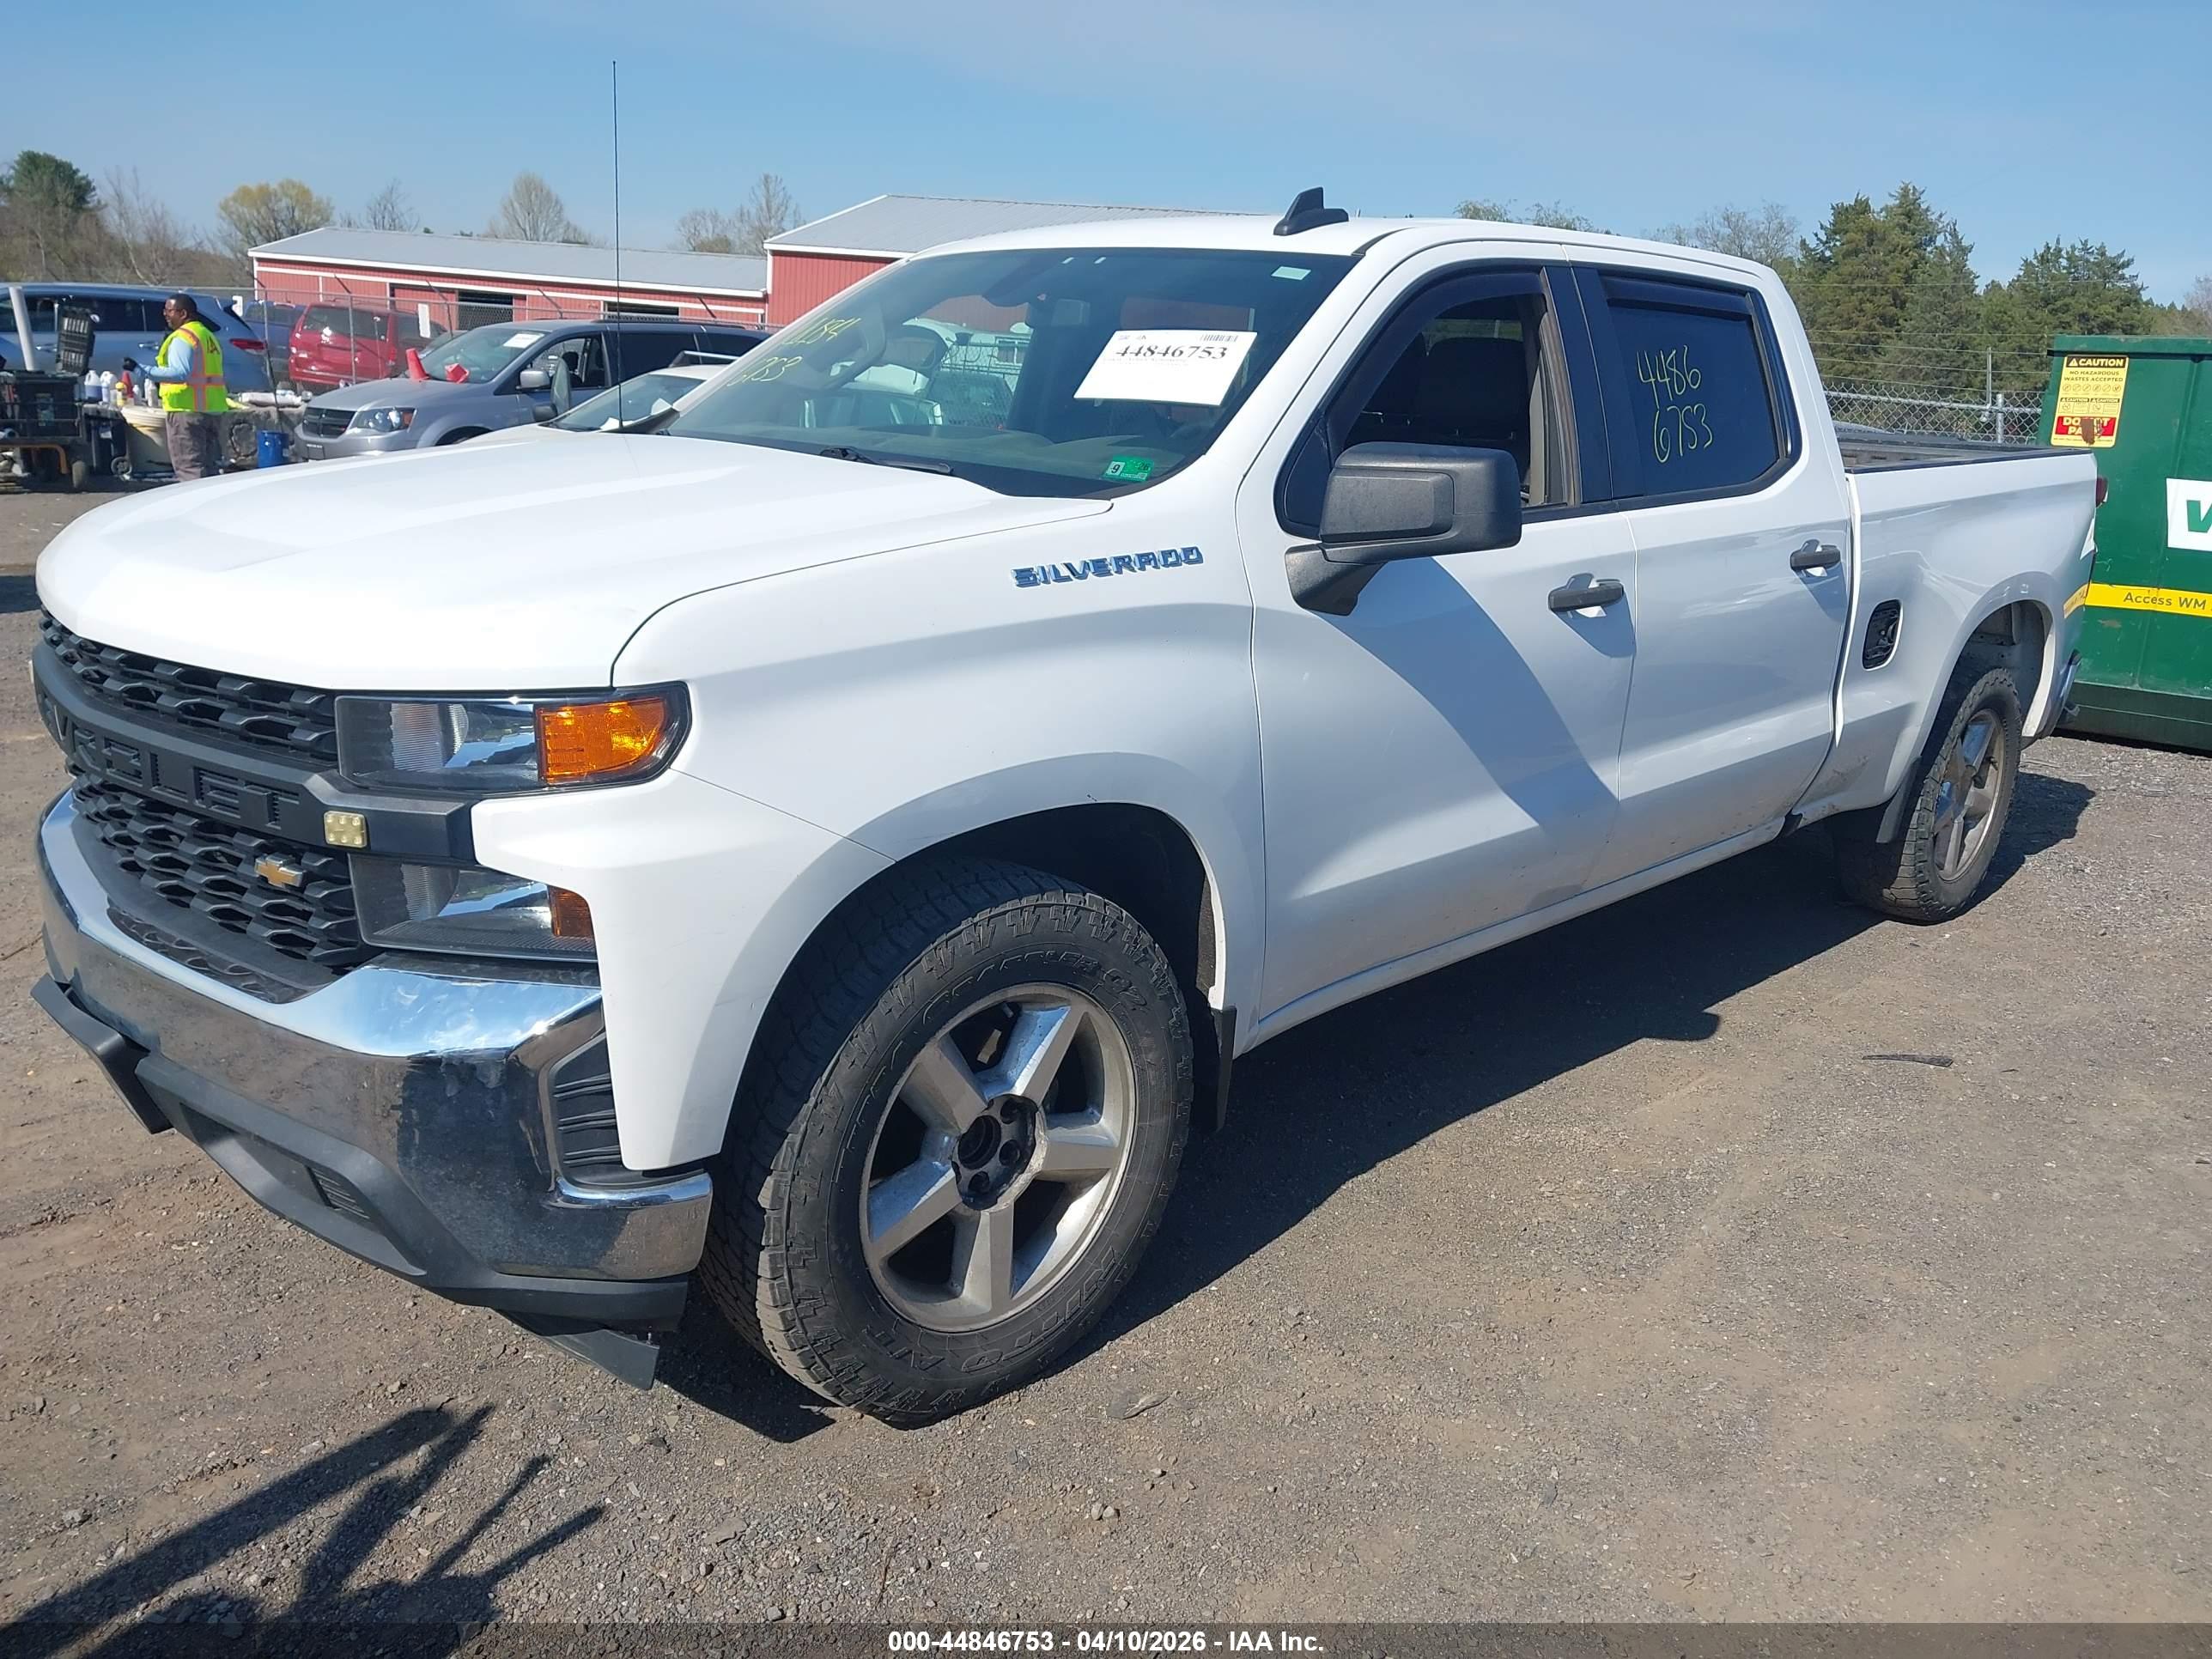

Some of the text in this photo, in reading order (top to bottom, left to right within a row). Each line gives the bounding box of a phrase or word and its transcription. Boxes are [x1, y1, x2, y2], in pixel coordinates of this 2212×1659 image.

[1115, 344, 1228, 359] 44846753
[2078, 358, 2124, 367] CAUTION
[1637, 344, 1701, 409] 4486
[2063, 416, 2081, 426] DO
[1654, 403, 1713, 463] 6753
[1111, 464, 1121, 473] 9
[1011, 546, 1204, 588] SILVERADO
[2124, 592, 2207, 611] Access WM
